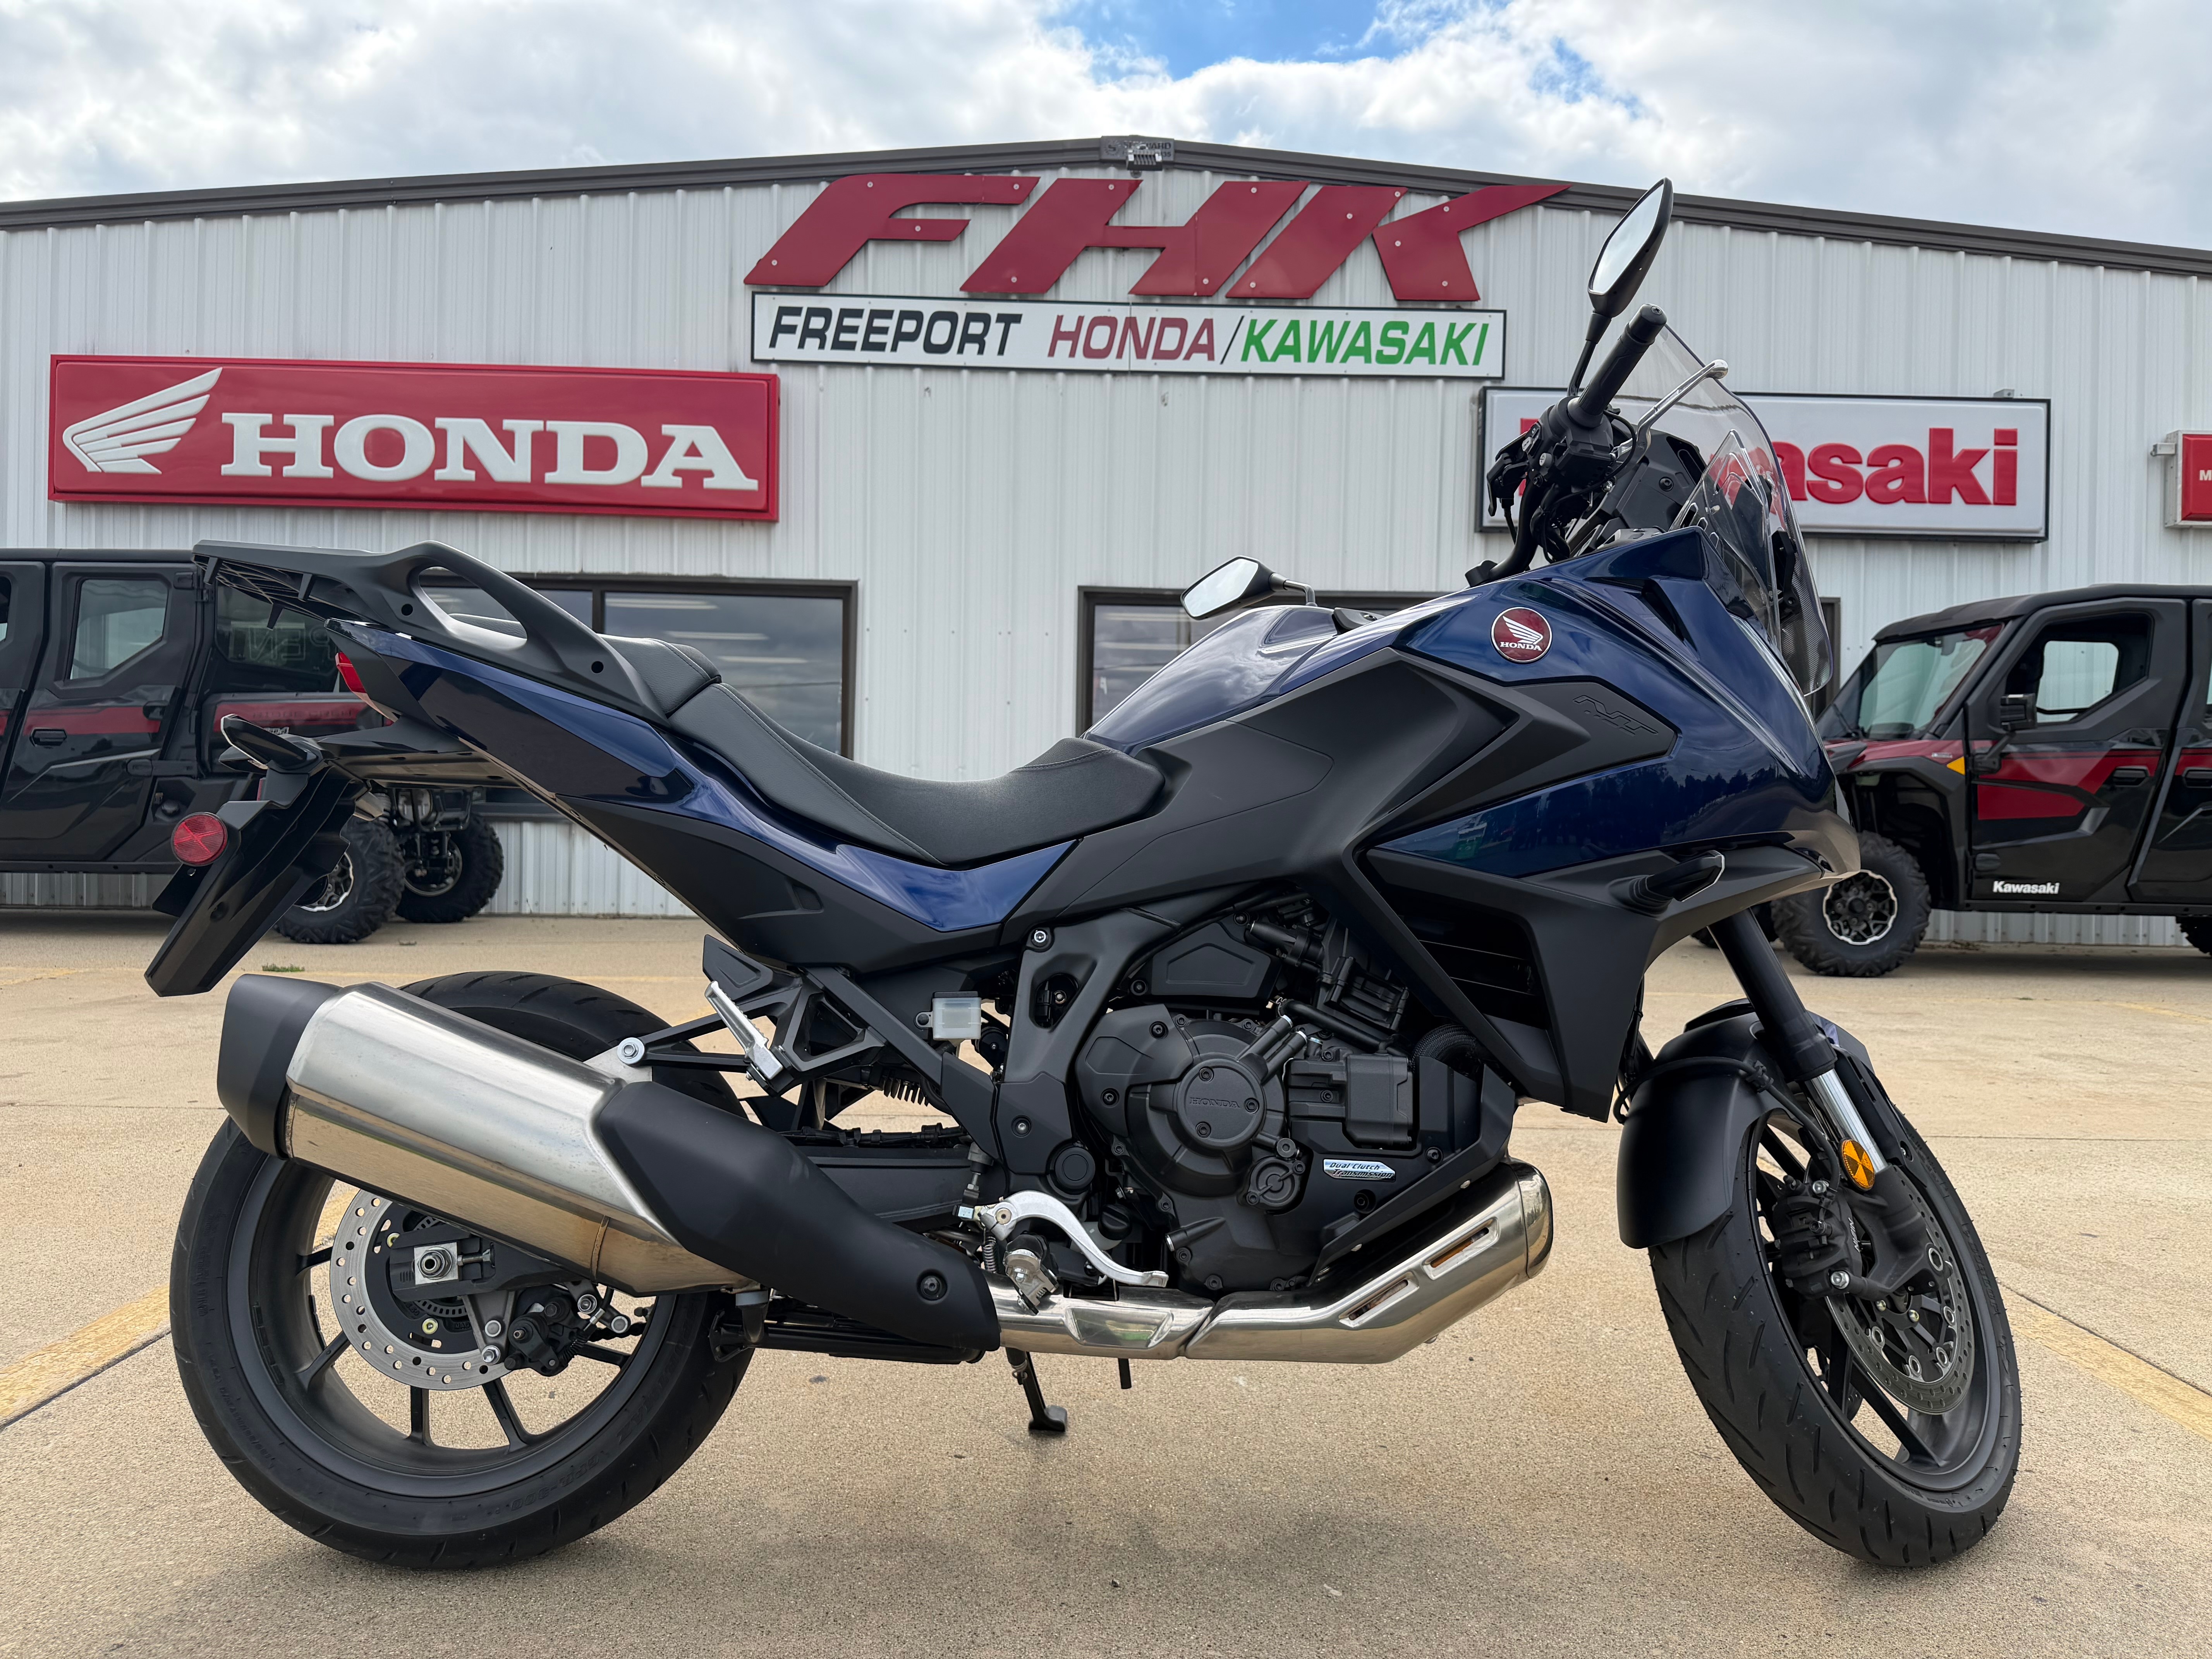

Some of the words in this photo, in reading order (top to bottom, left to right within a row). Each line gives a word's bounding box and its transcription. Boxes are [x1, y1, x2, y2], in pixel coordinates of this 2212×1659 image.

[744, 173, 1571, 301] FHK
[769, 306, 1023, 356] FREEPORT
[221, 412, 758, 490] HONDA
[1500, 641, 1542, 651] HONDA
[1993, 881, 2060, 895] Kawasaki
[1190, 1097, 1240, 1108] HONDA
[1333, 1169, 1393, 1178] Transmission
